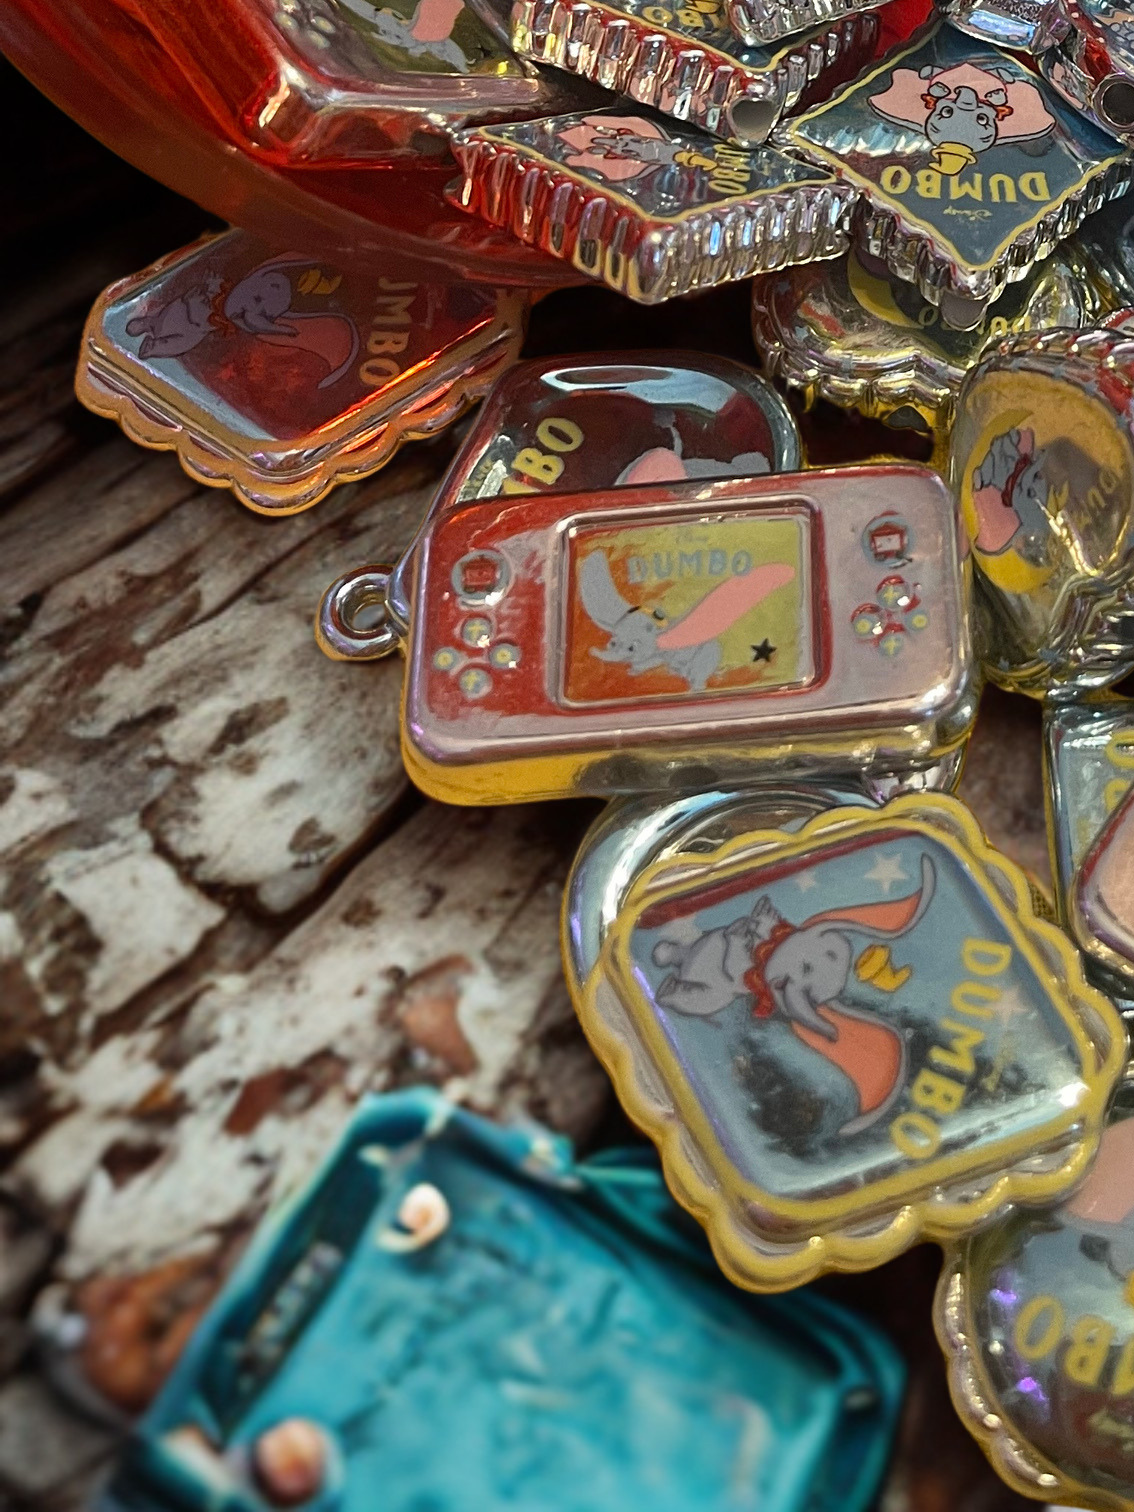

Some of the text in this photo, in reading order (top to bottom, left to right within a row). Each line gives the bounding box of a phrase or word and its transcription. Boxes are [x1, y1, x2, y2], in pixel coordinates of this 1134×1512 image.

[708, 137, 751, 194] UMBO
[880, 165, 1050, 203] DUMBO
[627, 548, 753, 584] DUMBO
[889, 936, 1012, 1159] DUMBO
